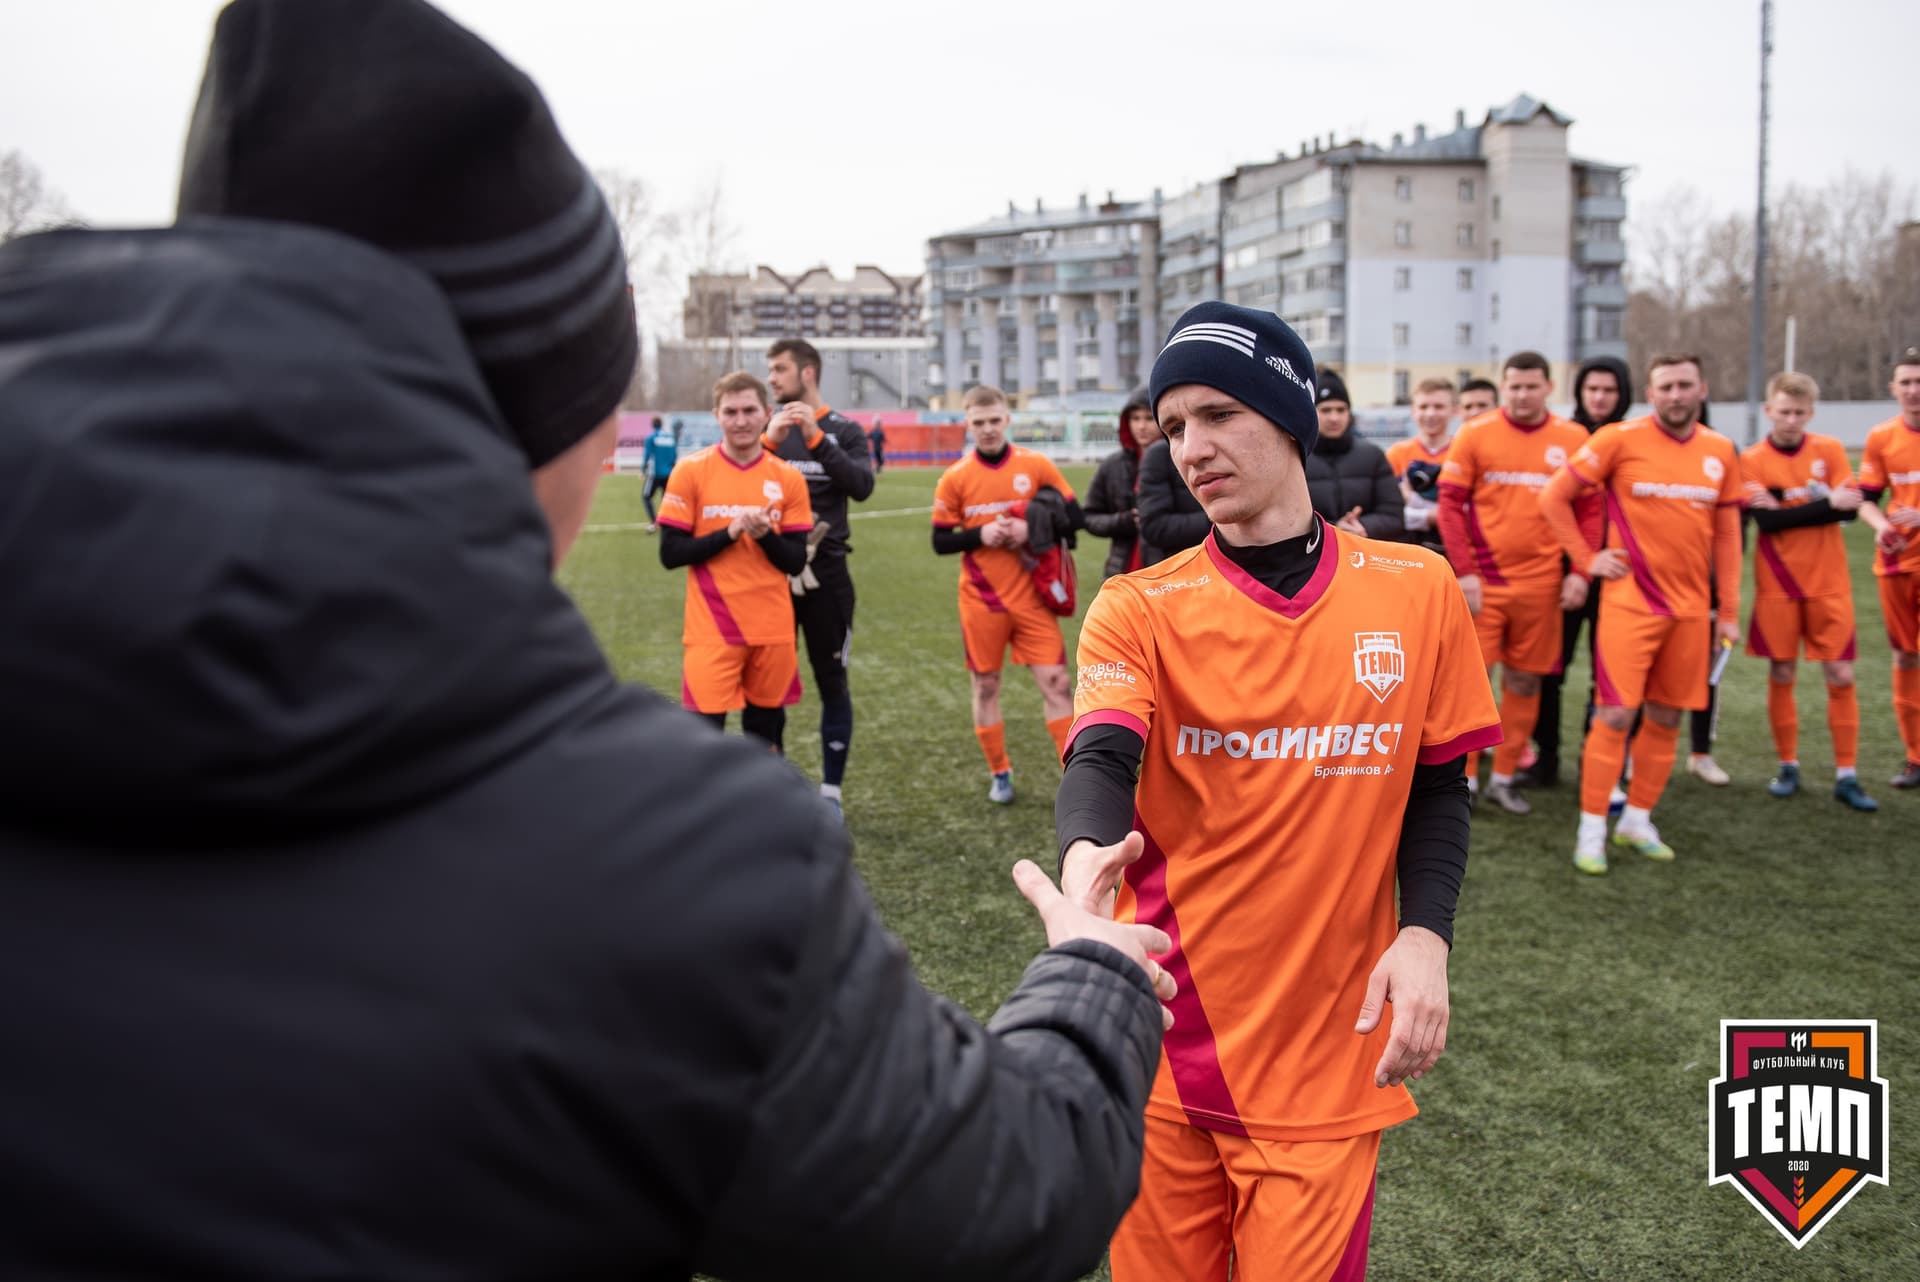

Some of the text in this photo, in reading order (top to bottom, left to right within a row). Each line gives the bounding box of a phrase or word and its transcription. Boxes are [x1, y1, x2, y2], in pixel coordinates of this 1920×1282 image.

[1079, 661, 1126, 674] ровое
[1358, 651, 1401, 677] ТЕМП
[1314, 765, 1381, 779] Бродников
